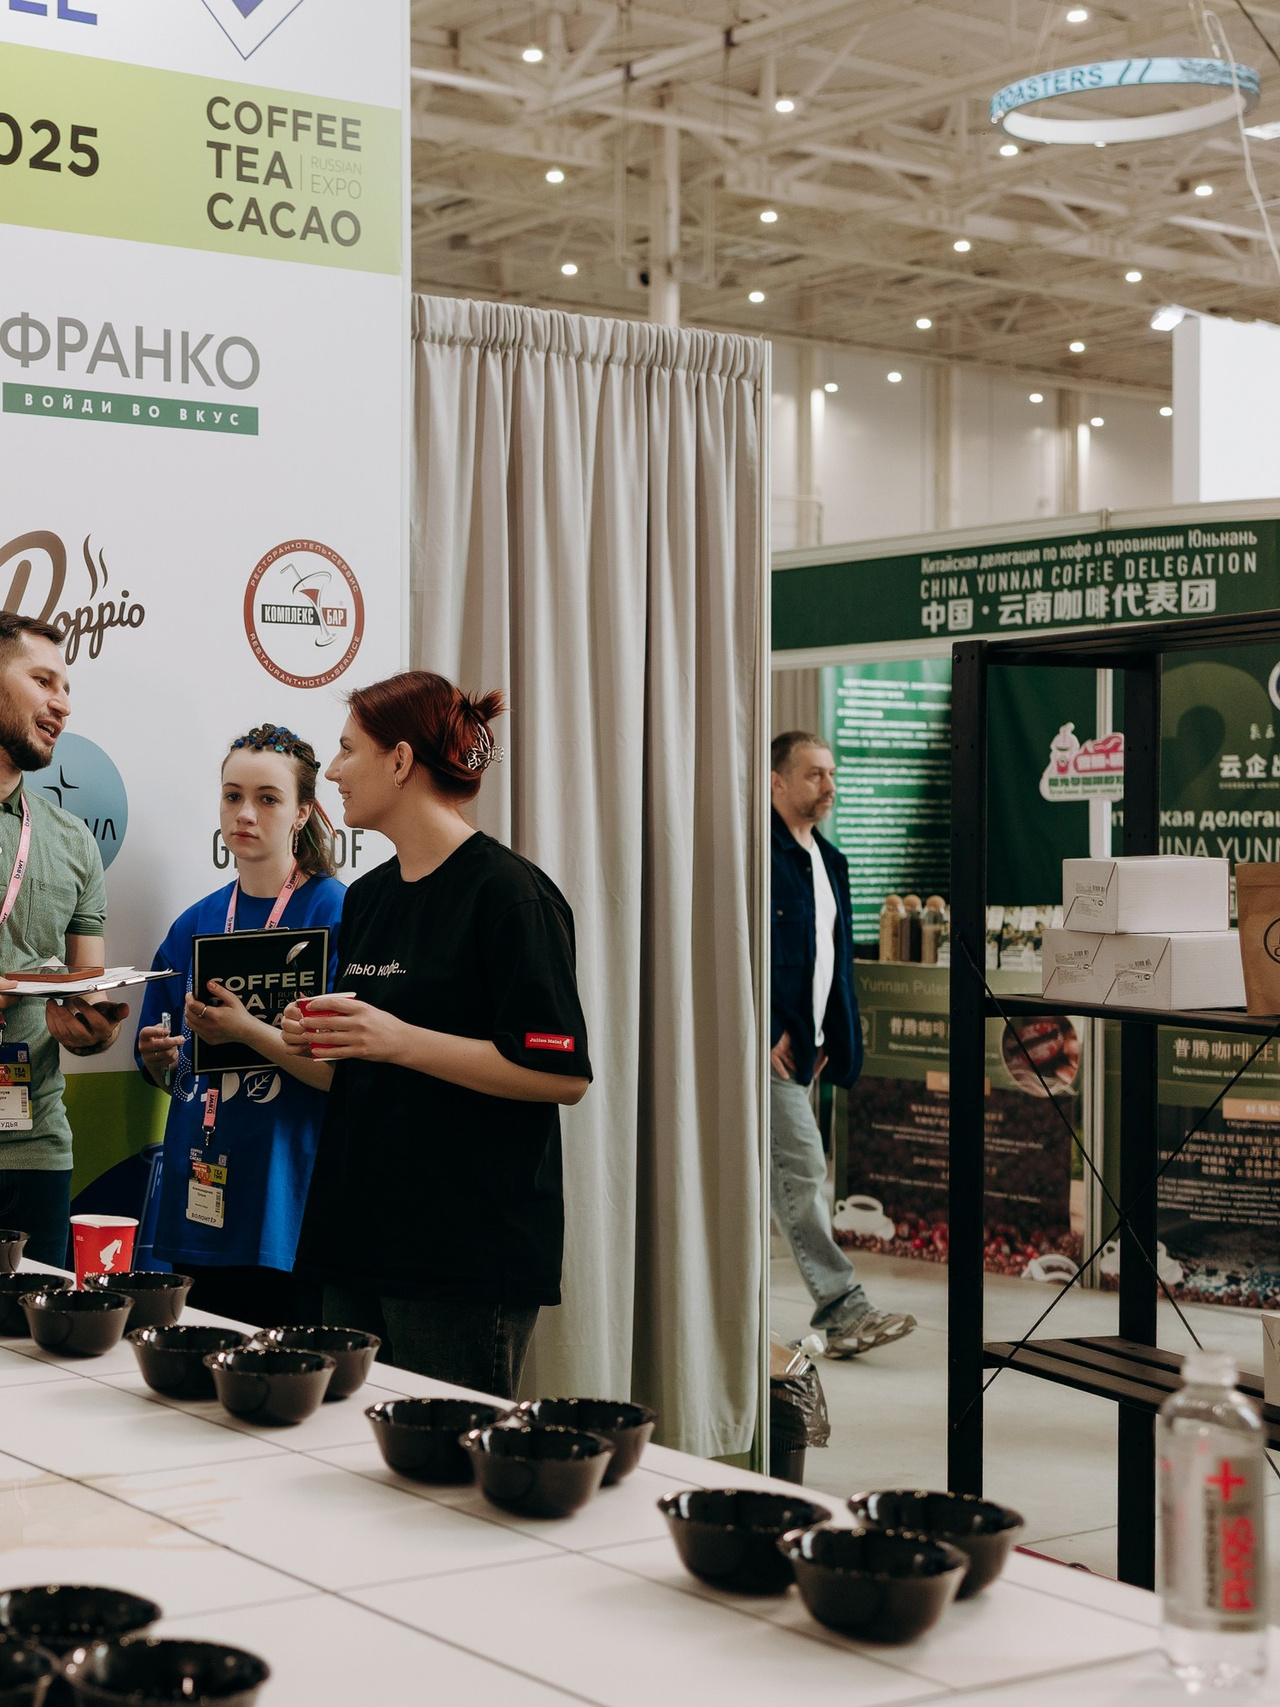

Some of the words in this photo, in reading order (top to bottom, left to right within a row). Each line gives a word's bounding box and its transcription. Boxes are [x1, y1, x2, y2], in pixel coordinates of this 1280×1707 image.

[206, 96, 362, 152] COFFEE
[206, 141, 292, 189] TEA
[310, 174, 362, 199] EXPO
[311, 156, 362, 176] RUSSIAN
[207, 192, 361, 247] CACAO
[0, 311, 260, 390] ФРАНКО
[25, 392, 113, 414] ВОЙДИ
[132, 403, 160, 419] ВО
[180, 407, 240, 427] ВКУС
[250, 544, 291, 587] РЕСТОРАН
[921, 555, 978, 575] Китайская
[980, 548, 1040, 571] делегация
[1042, 547, 1057, 561] по
[1059, 540, 1091, 562] кофе
[1106, 535, 1184, 559] провинции
[1188, 529, 1258, 548] Юньнань
[921, 576, 969, 600] CHINA
[976, 567, 1043, 594] YUNNAN
[1125, 551, 1258, 581] DELEGATION
[264, 605, 315, 624] КОМПЛЕКС
[326, 608, 345, 626] БАР
[249, 633, 300, 686] RESTAURANT
[301, 675, 332, 687] HOTEL
[333, 635, 360, 676] SERVICE
